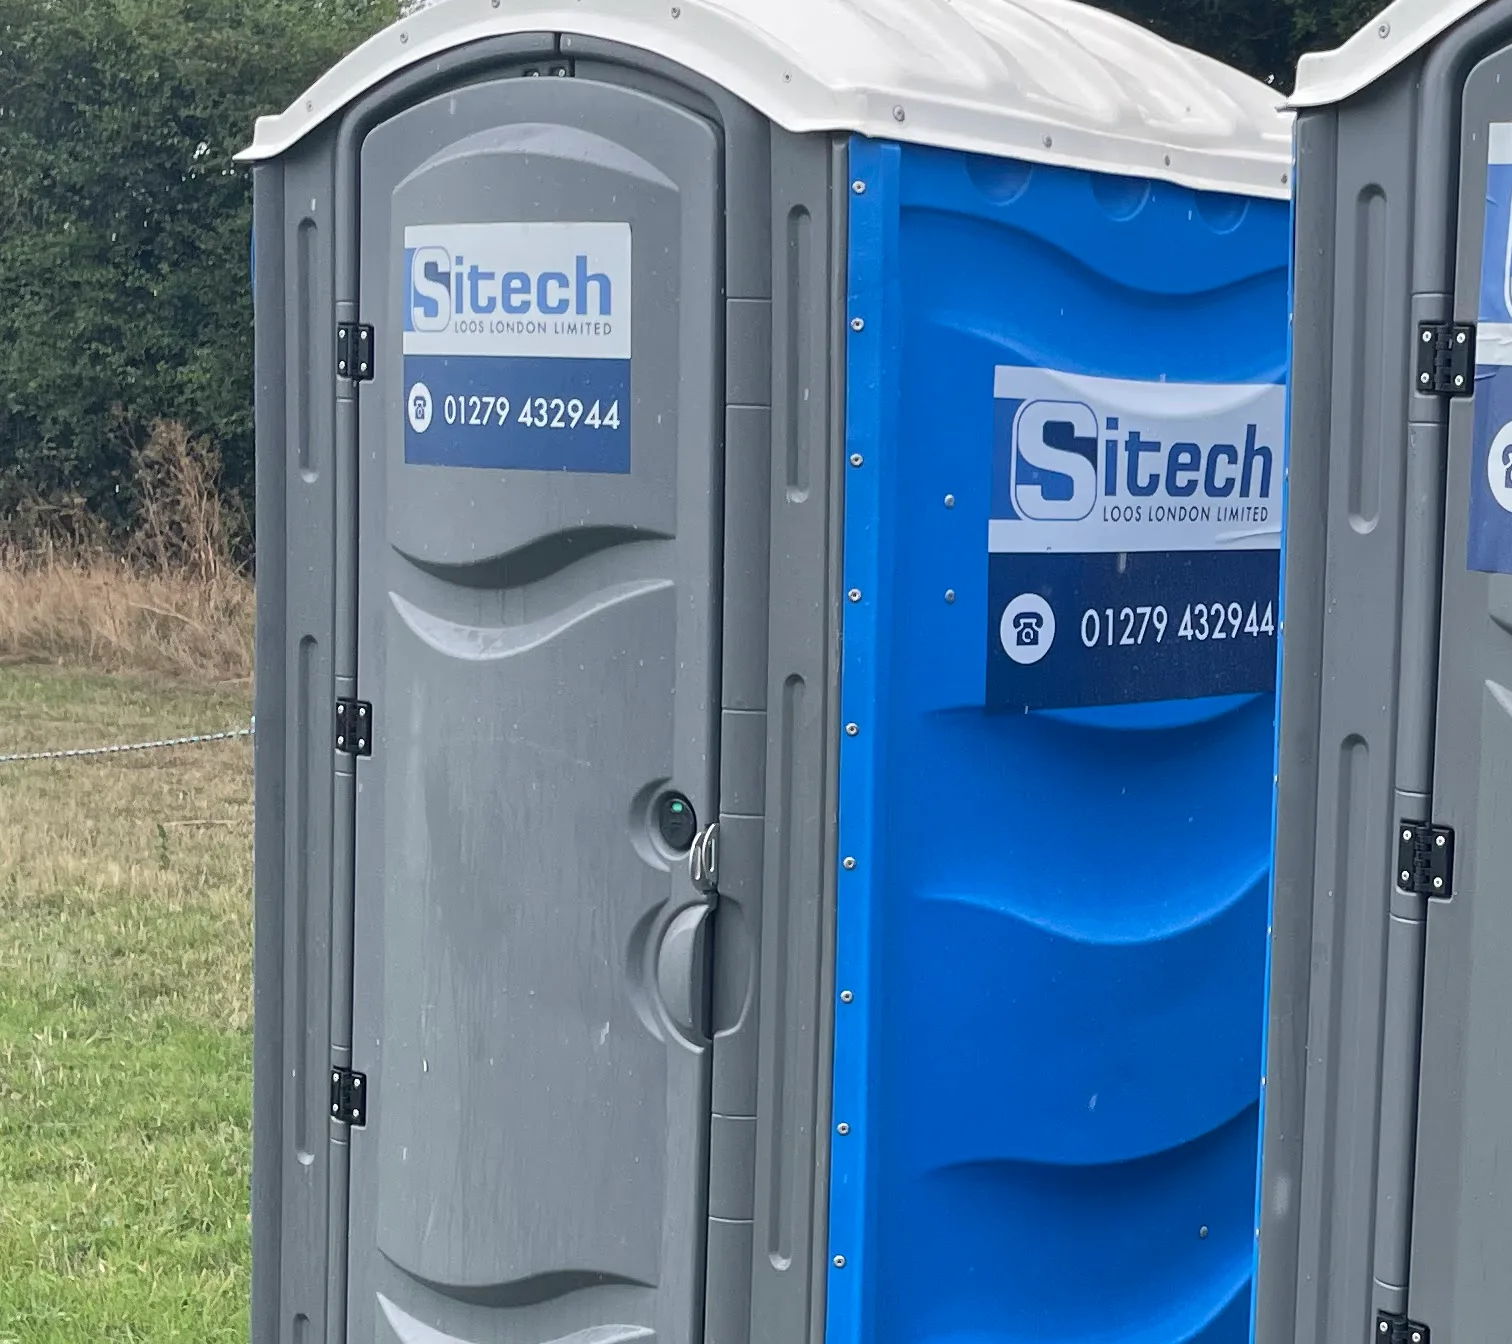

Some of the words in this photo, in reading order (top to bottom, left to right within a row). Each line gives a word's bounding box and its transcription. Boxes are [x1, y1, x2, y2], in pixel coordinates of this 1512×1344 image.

[411, 245, 612, 333] Sitech
[454, 319, 484, 334] LOOS
[490, 320, 547, 335] LONDON
[554, 321, 612, 336] LIMITED
[444, 394, 510, 426] 01279
[517, 397, 621, 430] 432944
[1010, 399, 1274, 522] Sitech
[1103, 505, 1143, 523] LOOS
[1148, 505, 1210, 523] LONDON
[1216, 506, 1269, 523] LIMITED
[1081, 605, 1168, 648] 01279
[1177, 600, 1275, 642] 432944
